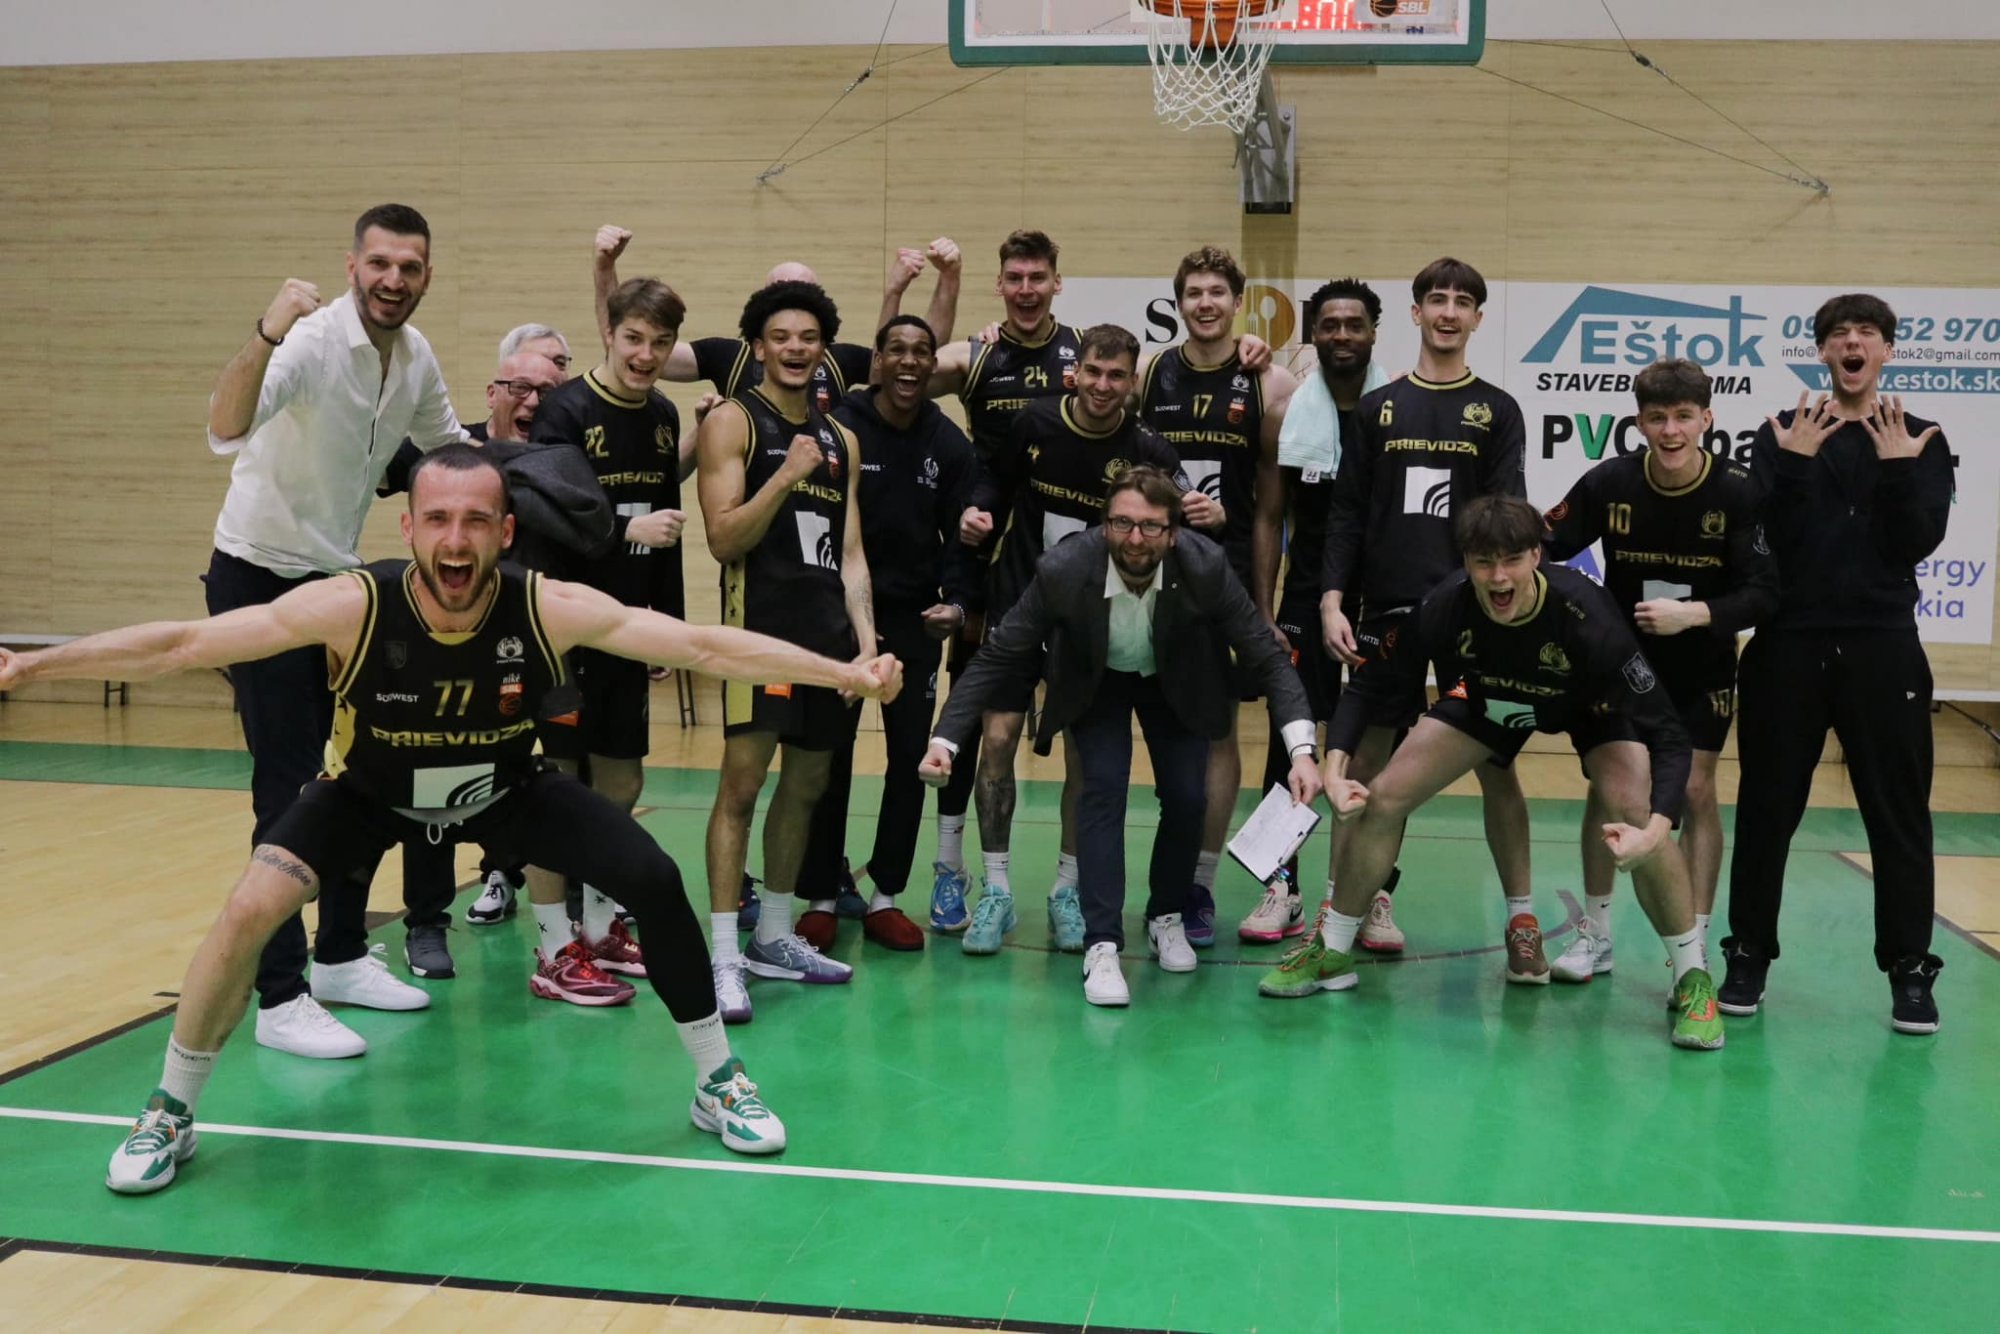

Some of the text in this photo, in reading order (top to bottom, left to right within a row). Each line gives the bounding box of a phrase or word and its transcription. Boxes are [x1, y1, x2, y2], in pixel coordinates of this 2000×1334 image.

[1581, 295, 1766, 367] Eštok
[1943, 317, 2000, 342] 970
[1890, 347, 2000, 363] stok2@gmail.com
[1024, 365, 1048, 388] 24
[1536, 372, 1638, 392] STAVEB
[1192, 394, 1213, 419] 17
[1379, 400, 1394, 427] 6
[1161, 430, 1249, 448] RIEVIDZA
[1384, 437, 1478, 456] PRIEVIDZA
[1030, 477, 1105, 508] PRIEVIDZ
[1607, 502, 1632, 535] 10
[1614, 550, 1724, 568] PRIEVIDZA
[1914, 558, 1986, 587] ergy
[433, 679, 475, 717] 77
[370, 718, 535, 747] PRIEVIDZA
